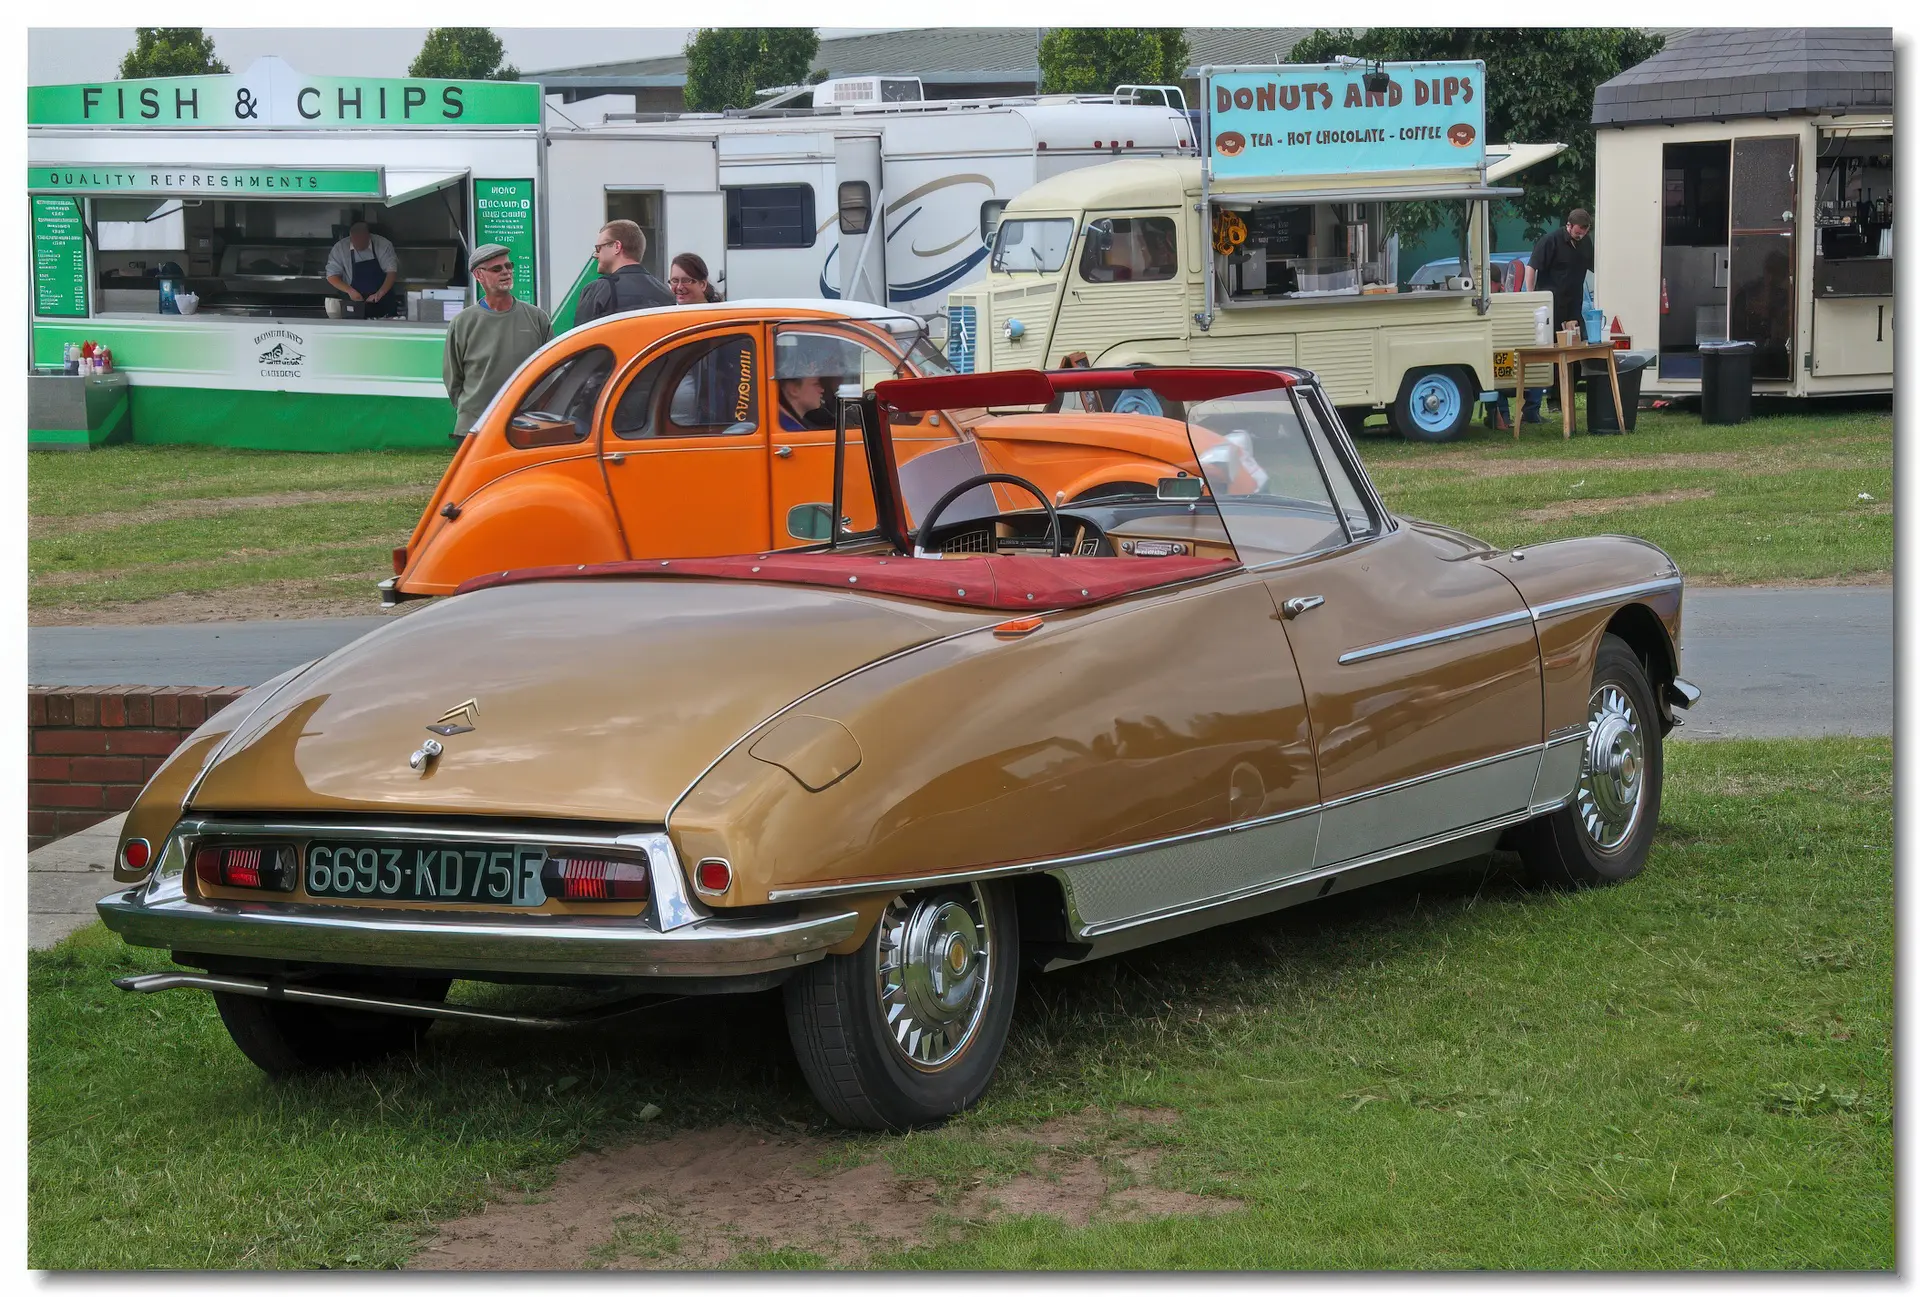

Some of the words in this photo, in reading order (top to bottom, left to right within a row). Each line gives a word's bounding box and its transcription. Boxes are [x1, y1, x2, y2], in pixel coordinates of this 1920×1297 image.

[83, 87, 199, 119] FISH
[234, 87, 258, 120] &
[297, 86, 464, 120] CHIPS
[1217, 82, 1333, 114] DONUTS
[1344, 80, 1403, 108] AND
[1414, 76, 1474, 107] DIPS
[1250, 133, 1273, 147] TEA
[1287, 130, 1312, 146] HOT
[1316, 128, 1385, 146] CHOCOLATE
[1399, 126, 1442, 140] COFFEE
[50, 173, 136, 186] QUALITY
[150, 174, 318, 189] REFRESHMENTS
